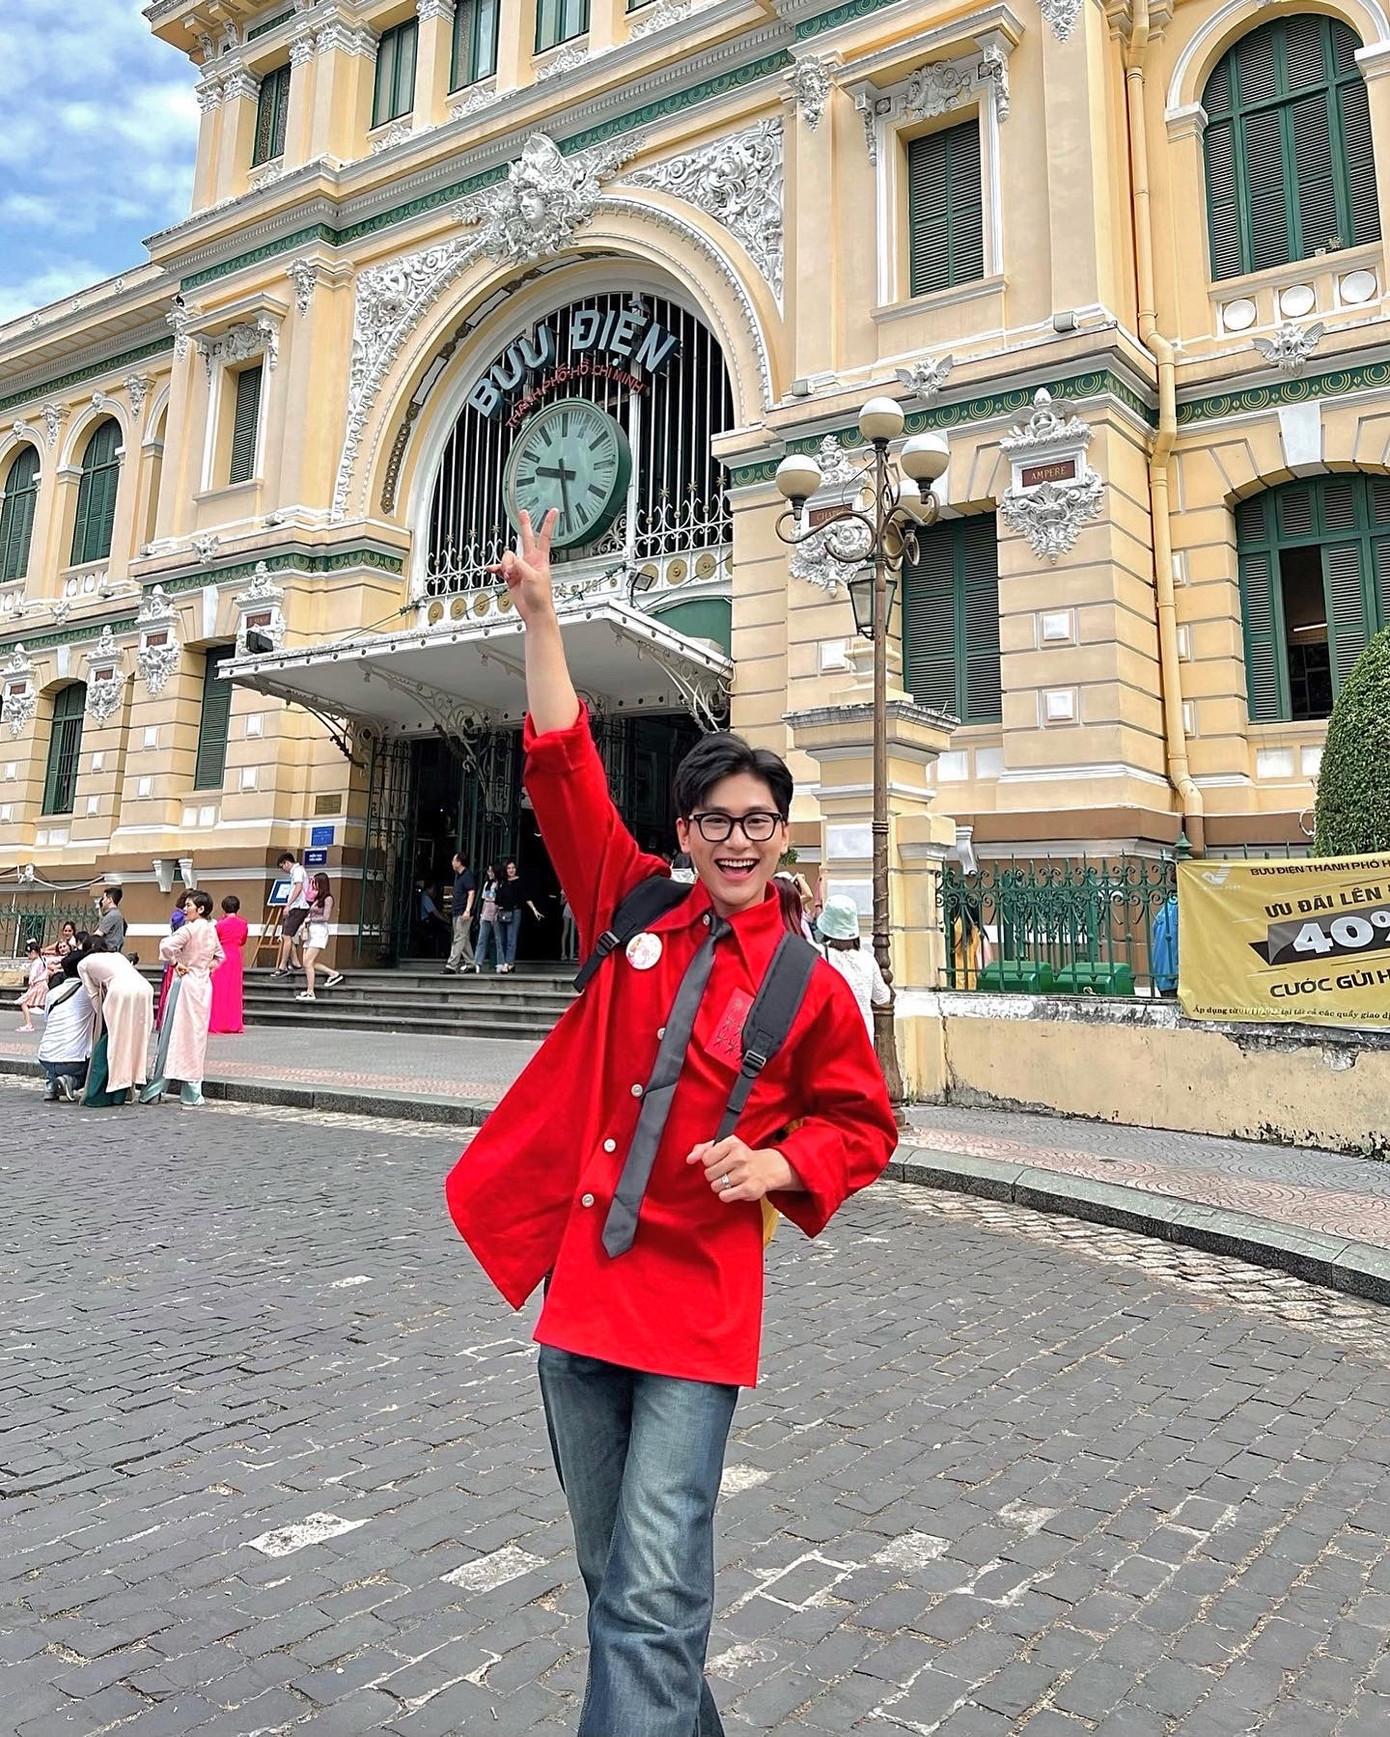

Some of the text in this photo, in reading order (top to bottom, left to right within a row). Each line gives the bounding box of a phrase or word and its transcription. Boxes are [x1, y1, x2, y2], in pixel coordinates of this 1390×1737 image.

[468, 299, 678, 418] BƯU ĐIỆN
[613, 368, 644, 394] MINH
[1031, 466, 1067, 480] AMPERE
[1265, 887, 1382, 918] ƯU ĐÃI LÊN
[1270, 977, 1333, 998] CƯỚC
[1336, 968, 1375, 990] GỬI
[1206, 1006, 1227, 1015] dụng
[1360, 1011, 1380, 1019] giao
